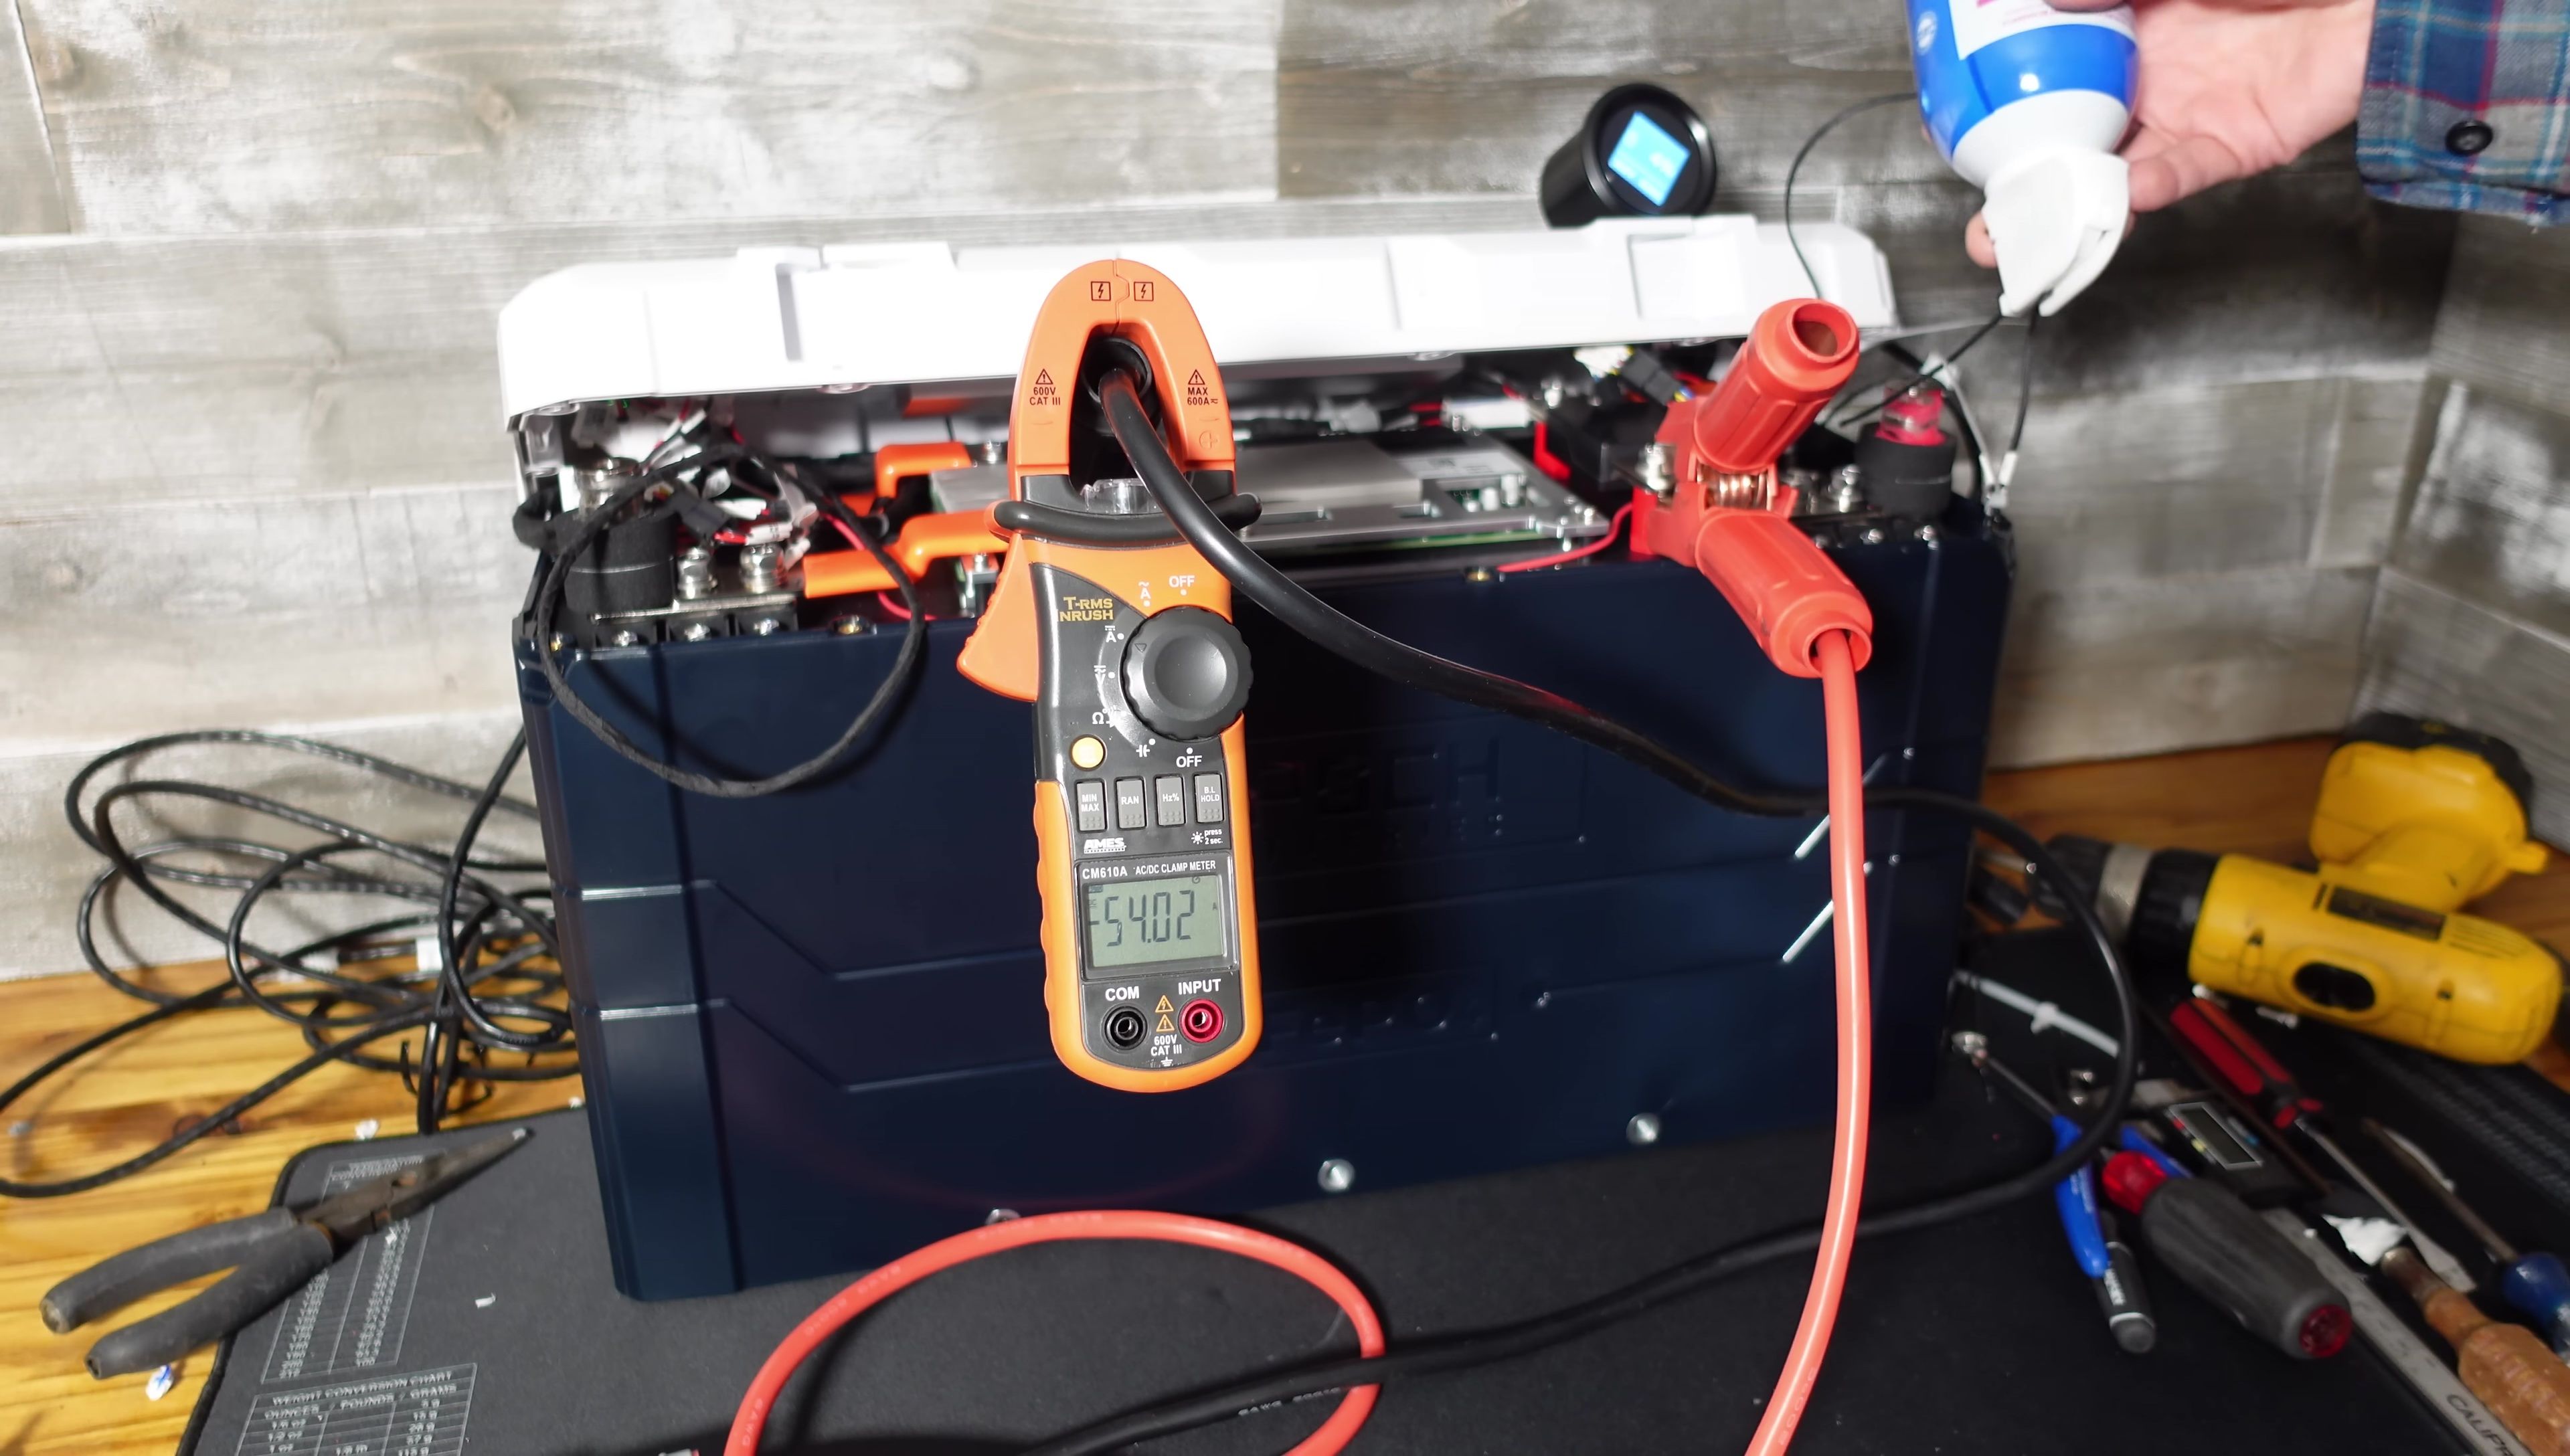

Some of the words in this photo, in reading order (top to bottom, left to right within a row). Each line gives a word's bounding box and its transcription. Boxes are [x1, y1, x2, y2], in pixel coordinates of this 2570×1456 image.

[1033, 386, 1056, 395] 600V
[1187, 387, 1209, 395] MAX
[1029, 396, 1049, 405] CAT
[1052, 397, 1061, 405] III
[1169, 575, 1195, 587] OFF
[1063, 596, 1113, 610] T-RMS
[1176, 755, 1203, 767] OFF
[1082, 794, 1098, 802] MIN
[1121, 796, 1139, 805] RAN
[1163, 793, 1180, 802] Hz%
[1201, 794, 1220, 802] HOLD
[1081, 804, 1100, 812] MAX
[1204, 829, 1223, 837] press
[1084, 837, 1124, 849] AMES
[1082, 866, 1128, 879] CM610A
[1135, 862, 1159, 875] AC/DC
[1161, 862, 1188, 874] CLAMP
[1189, 859, 1216, 871] METER
[1178, 978, 1221, 995] INPUT
[1105, 986, 1140, 1002] COM
[1154, 1034, 1177, 1046] 600V
[1150, 1045, 1170, 1057] CAT
[1173, 1044, 1182, 1055] III
[325, 1377, 408, 1398] CONVERSION
[409, 1371, 452, 1386] CHART
[264, 1404, 320, 1421] OUNCES
[340, 1392, 395, 1410] POUNDS
[410, 1383, 457, 1399] GRAMS
